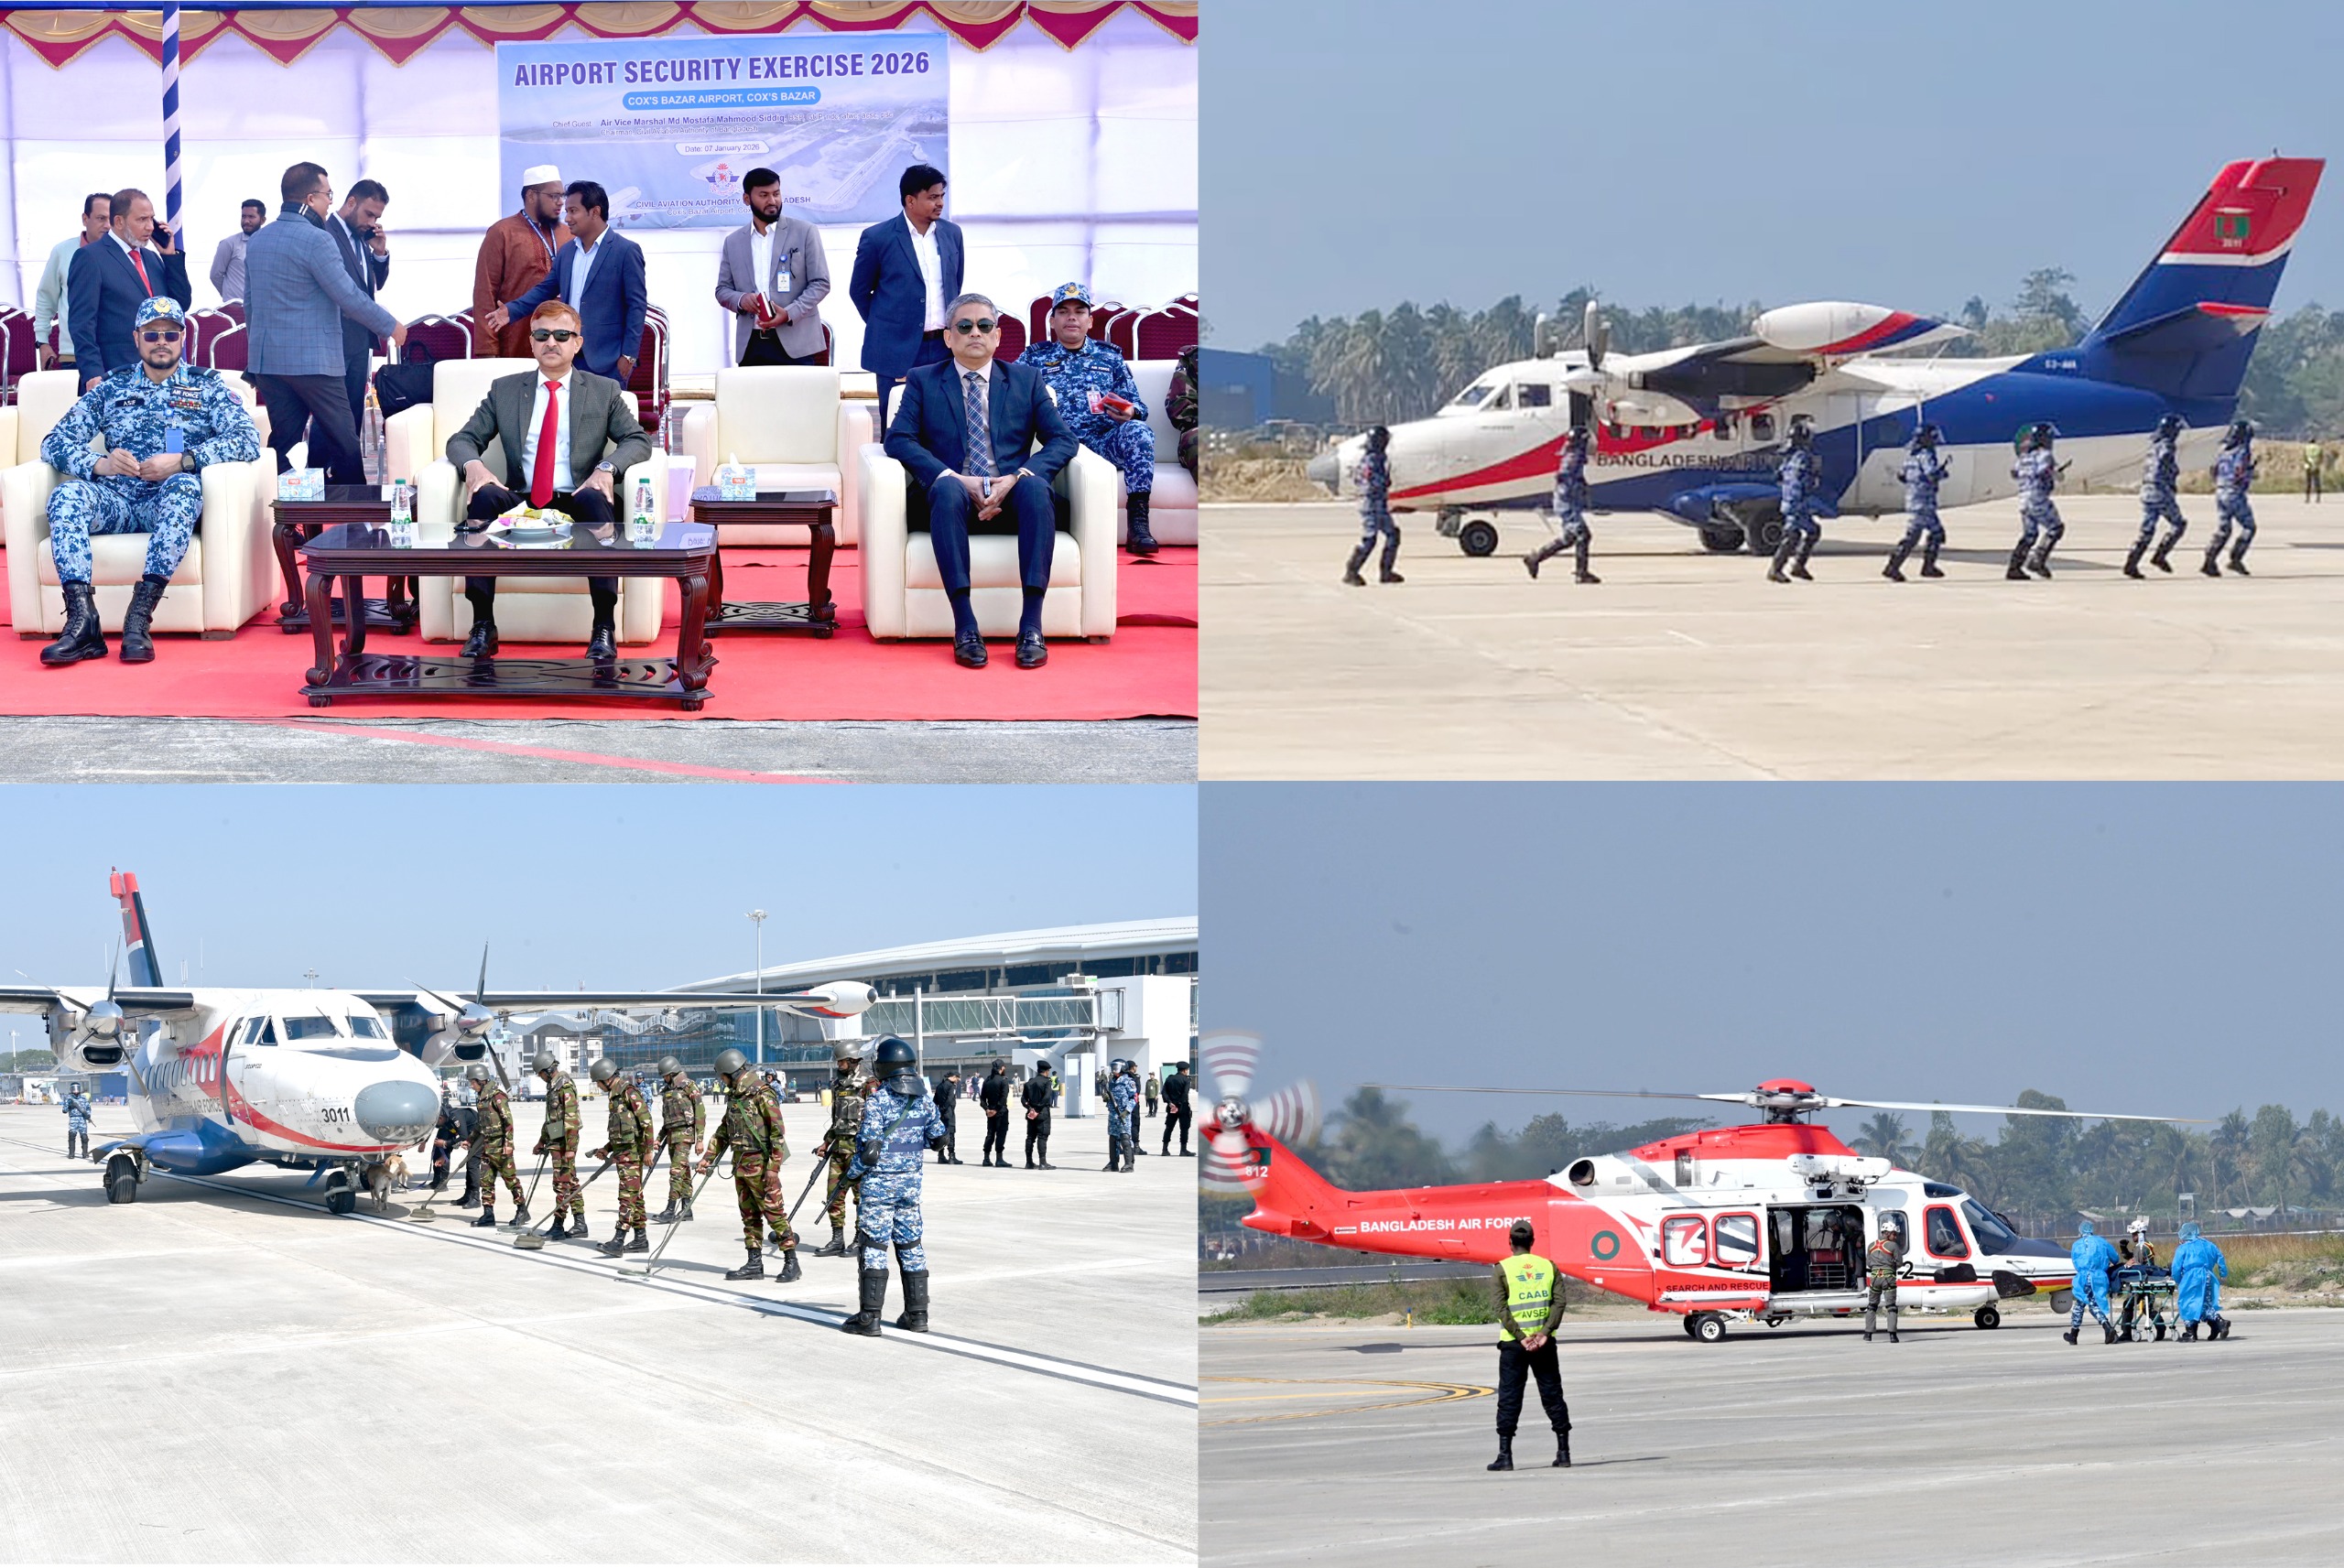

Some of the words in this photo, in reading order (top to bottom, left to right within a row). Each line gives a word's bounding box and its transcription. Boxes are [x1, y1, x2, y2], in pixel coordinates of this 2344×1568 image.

[515, 62, 617, 86] AIRPORT
[624, 58, 742, 83] SECURITY
[749, 53, 863, 80] EXERCISE
[871, 51, 929, 75] 2026
[628, 96, 658, 106] COX'S
[661, 95, 696, 105] BAZAR
[698, 93, 744, 104] AIRPORT,
[746, 92, 778, 103] COX'S
[780, 91, 816, 102] BAZAR
[552, 120, 570, 128] Chief
[571, 120, 592, 128] Guest
[600, 119, 612, 127] Air
[614, 118, 632, 126] Vice
[634, 117, 666, 126] Marshal
[667, 116, 680, 125] Md
[682, 115, 714, 124] Mostafa
[716, 114, 756, 124] Mahmood
[636, 127, 651, 135] Civil
[651, 126, 678, 135] Aviation
[679, 125, 708, 135] Authority
[711, 124, 717, 134] of
[719, 124, 758, 134] Bangladesh
[714, 145, 742, 153] January
[635, 200, 656, 209] CIVIL
[657, 200, 693, 208] AVIATION
[695, 198, 741, 207] AUTHORITY
[783, 196, 811, 204] ADESH
[689, 208, 709, 216] Bazar
[183, 390, 200, 398] FORCE
[1597, 453, 1720, 468] BANGLADESH
[202, 1098, 222, 1113] FORCE
[321, 1107, 350, 1123] 3011
[1245, 1165, 1268, 1178] 812
[1361, 1219, 1455, 1232] BANGLADESH
[1458, 1218, 1481, 1229] AIR
[1666, 1284, 1705, 1292] SEARCH
[1707, 1283, 1728, 1292] AND
[1730, 1281, 1769, 1291] RESCUE
[1518, 1290, 1549, 1300] CAAB
